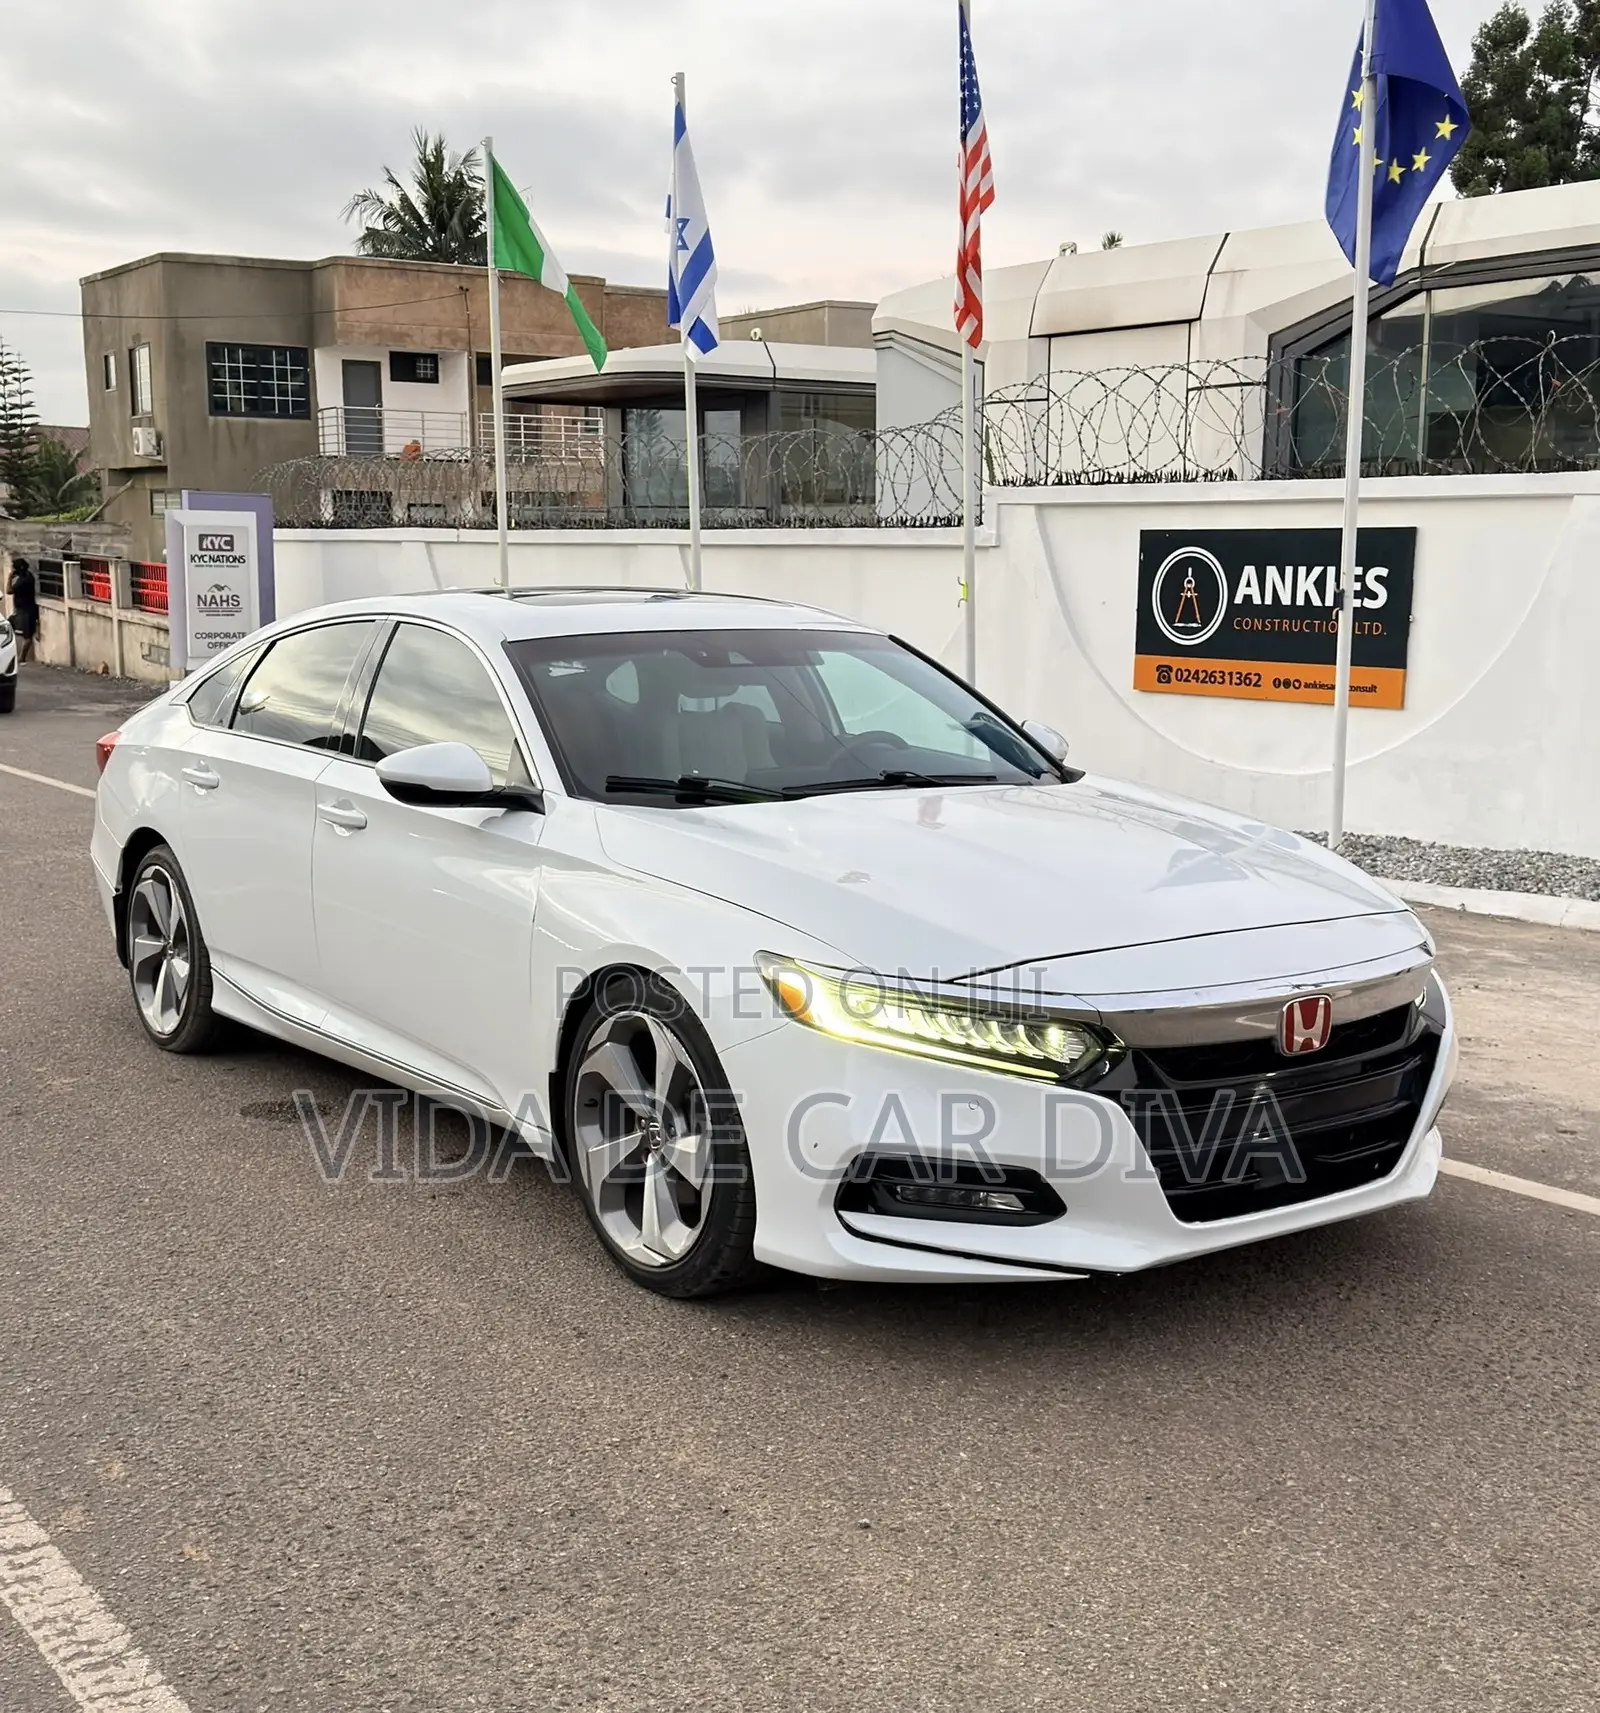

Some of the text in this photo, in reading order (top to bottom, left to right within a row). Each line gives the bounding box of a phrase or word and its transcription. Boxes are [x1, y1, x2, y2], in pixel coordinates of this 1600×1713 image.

[202, 535, 231, 550] KYC
[190, 554, 246, 564] KYC NATIONS
[197, 594, 241, 607] NAHS
[1233, 617, 1387, 635] CONSTRUCTIO LTD.
[194, 632, 247, 640] CORPORATE
[207, 641, 236, 650] OFFIC
[1175, 667, 1262, 688] 0242631362
